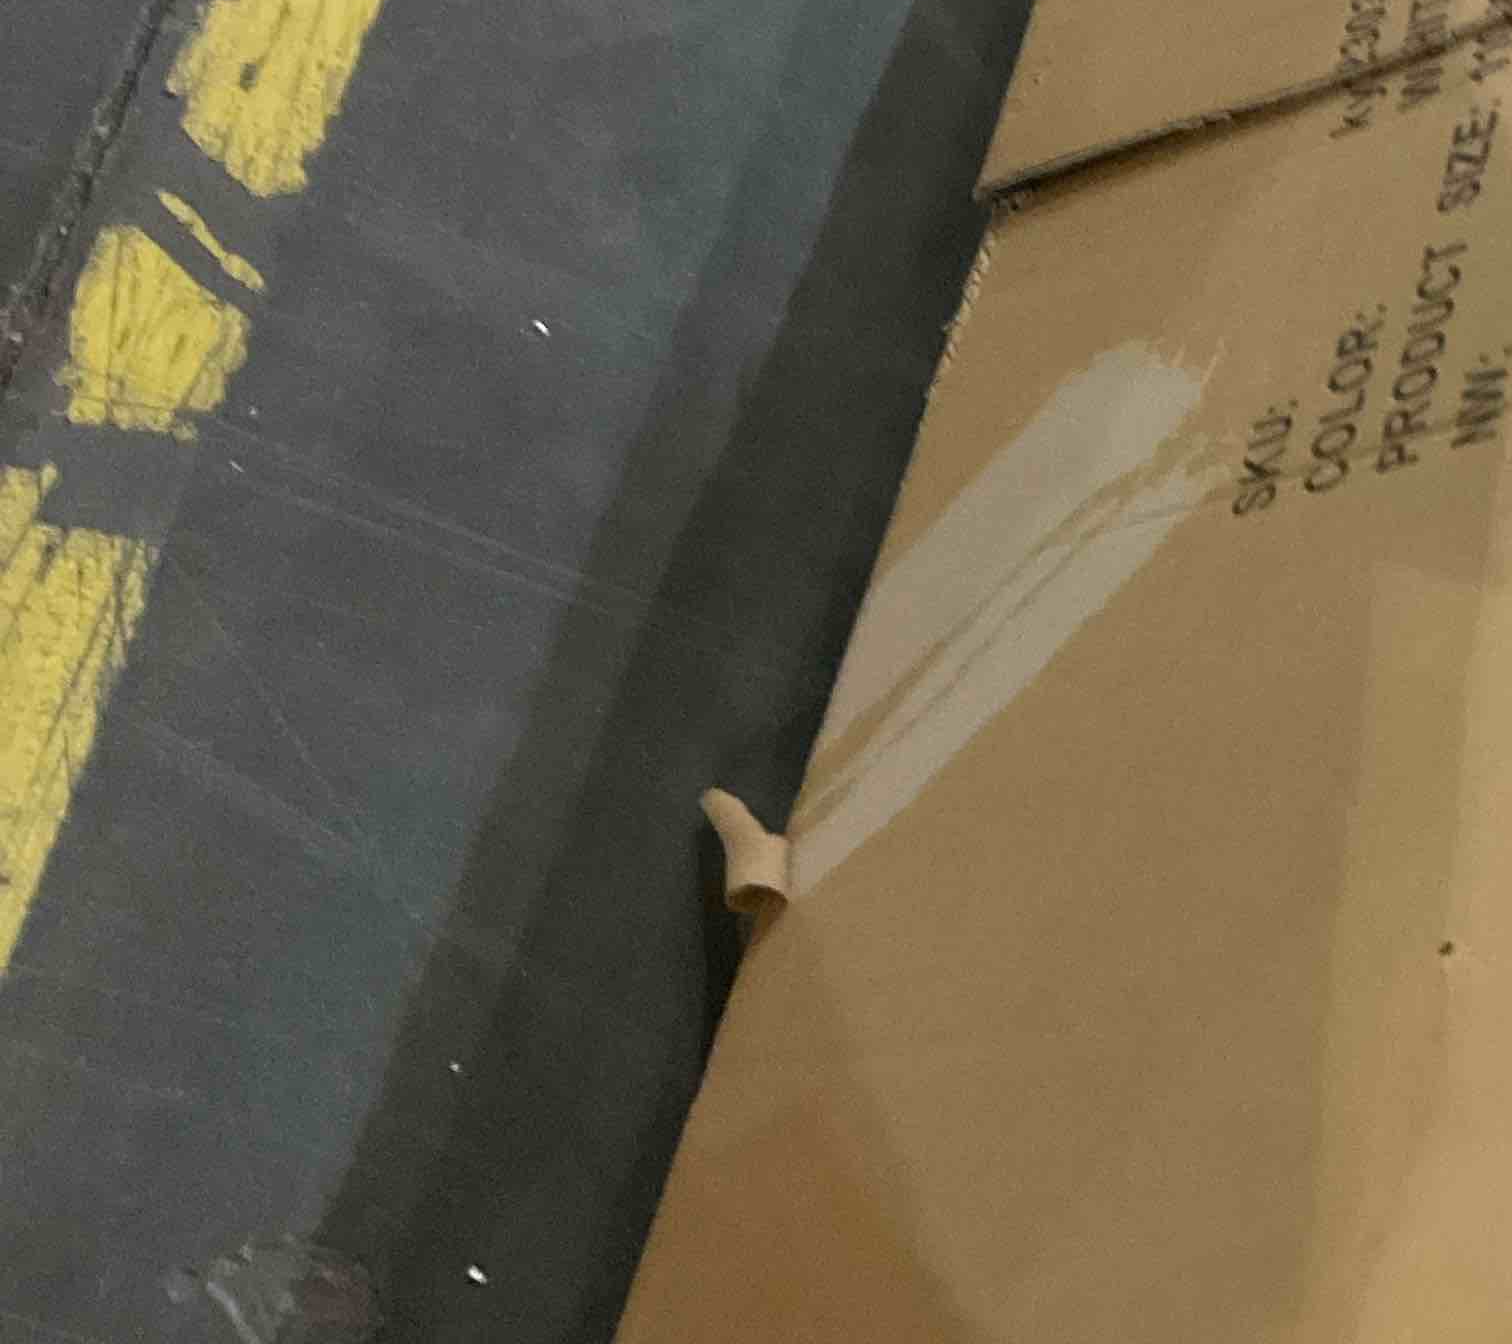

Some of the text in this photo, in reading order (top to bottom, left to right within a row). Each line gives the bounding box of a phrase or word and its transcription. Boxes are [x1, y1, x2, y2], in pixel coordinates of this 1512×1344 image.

[1376, 242, 1466, 473] PRODUCT
[1437, 98, 1501, 212] SIZE:
[1232, 399, 1298, 516] SKU:
[1304, 304, 1386, 493] COLOR:
[1451, 344, 1512, 449] NW:
